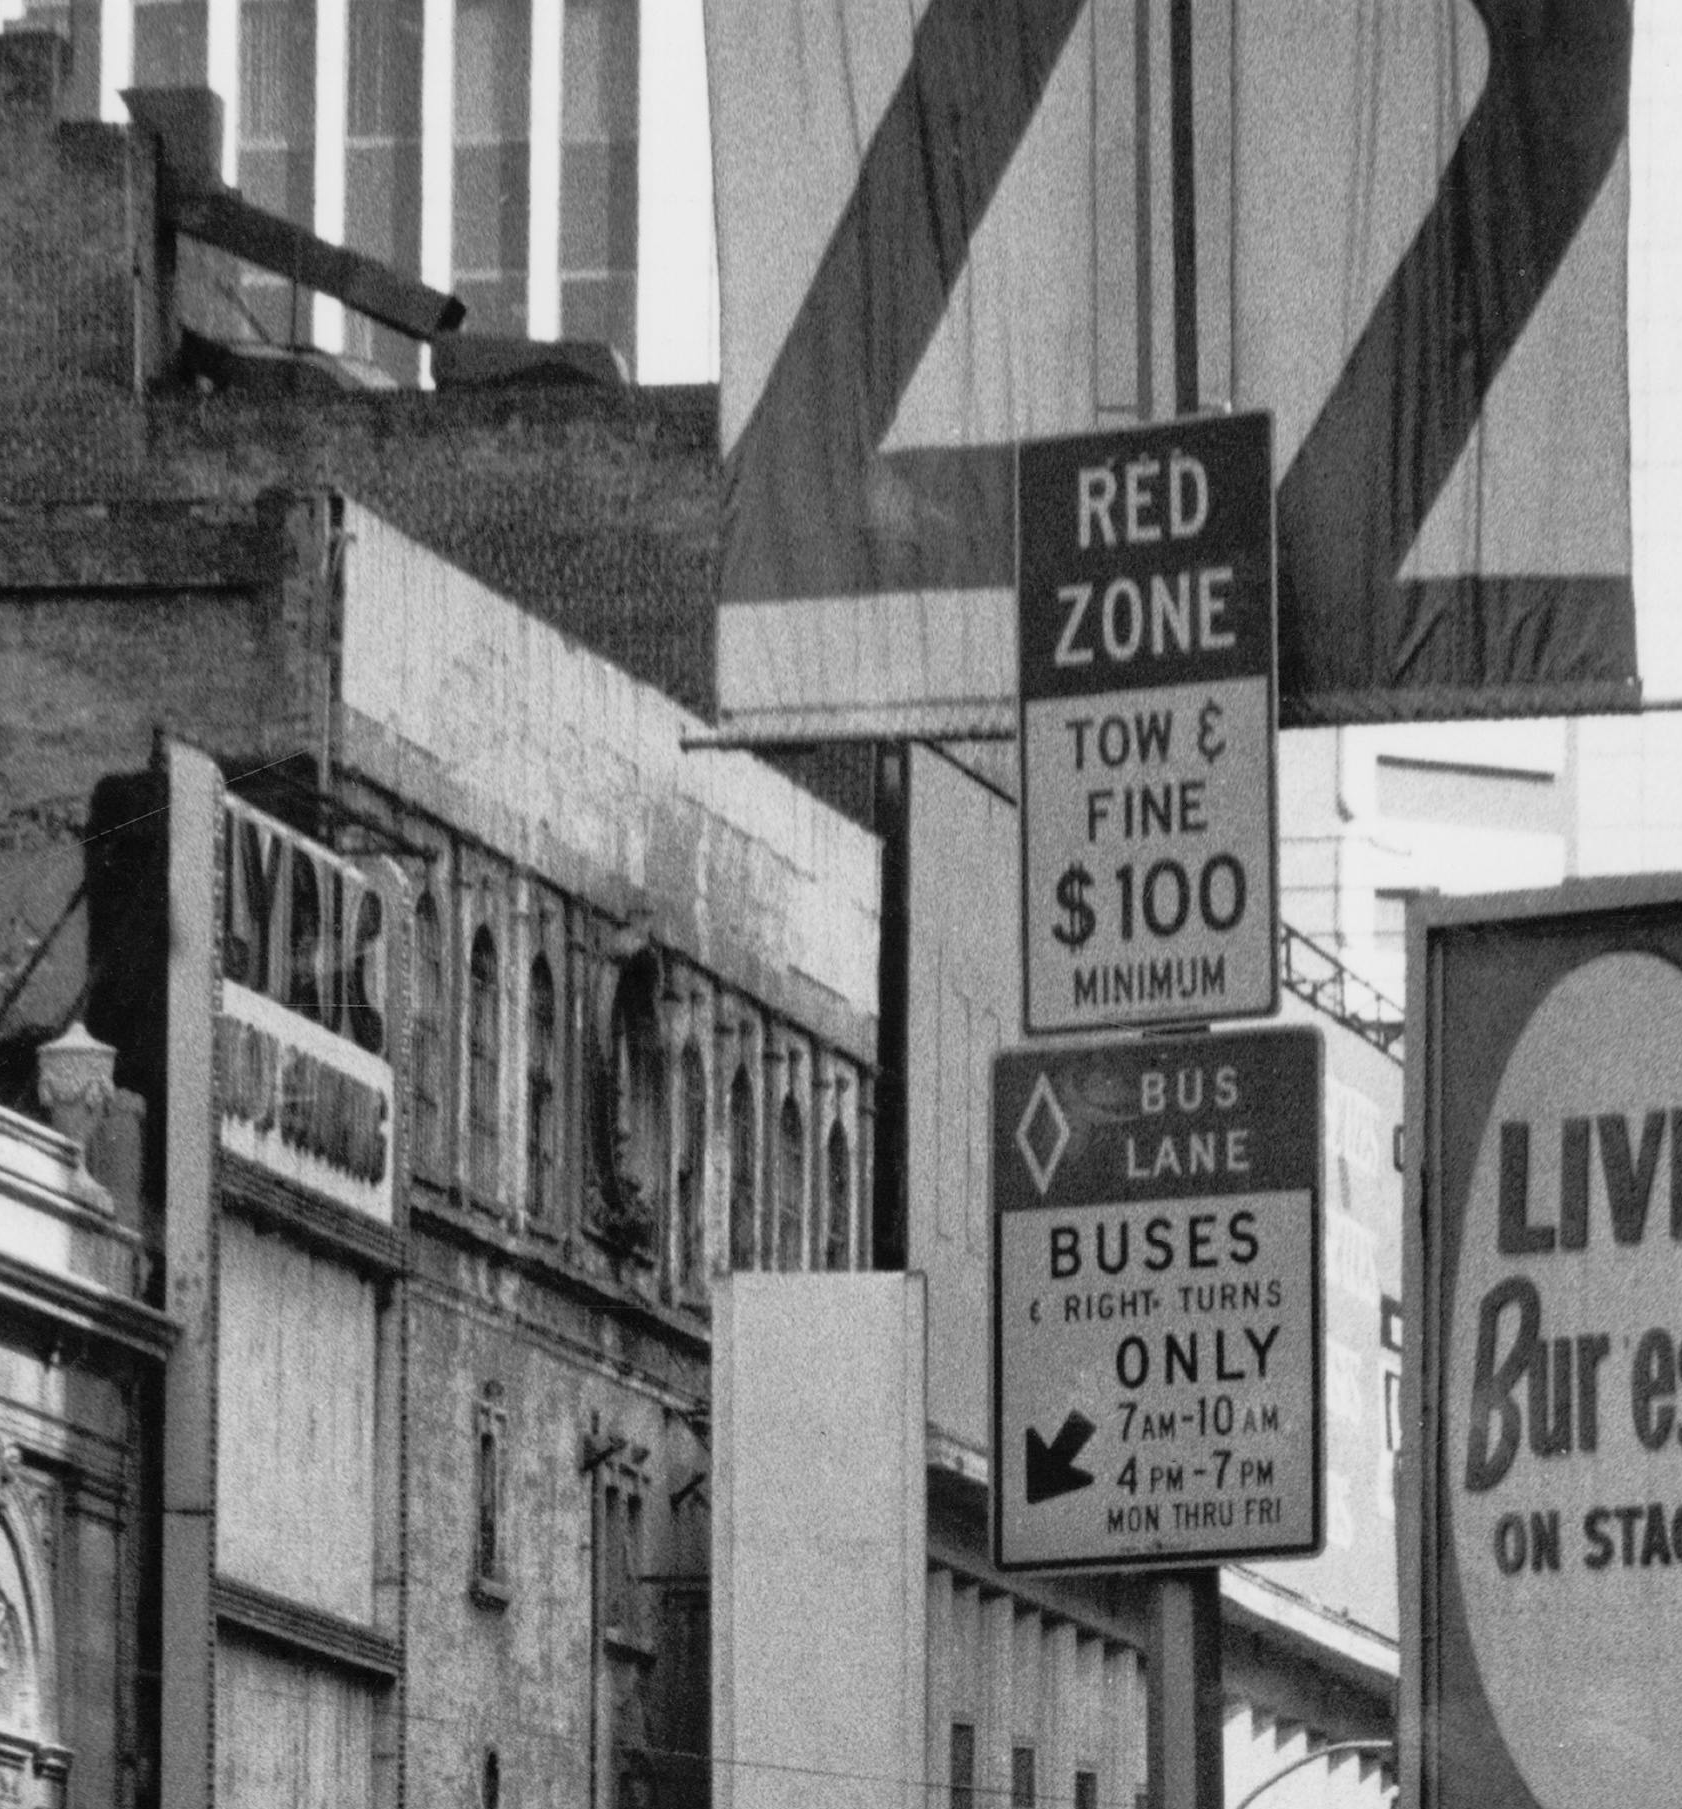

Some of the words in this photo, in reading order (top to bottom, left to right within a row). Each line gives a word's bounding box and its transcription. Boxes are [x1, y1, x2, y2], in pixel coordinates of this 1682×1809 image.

[1078, 452, 1209, 549] RED
[1054, 566, 1236, 668] ZONE
[1065, 710, 1174, 772] TOW
[1197, 699, 1226, 763] &
[1089, 780, 1208, 842] FINE
[1050, 853, 1247, 953] $100
[1074, 955, 1226, 1008] MINIMUM
[1141, 1066, 1238, 1115] BUS
[1126, 1130, 1251, 1181] LANE
[1050, 1211, 1259, 1280] BUSES
[1064, 1289, 1155, 1323] RIGHT
[1178, 1280, 1282, 1313] TURNS
[1116, 1326, 1281, 1389] ONLY
[1107, 1502, 1160, 1535] MON
[1172, 1500, 1234, 1530] THRU
[1245, 1498, 1282, 1525] FRI
[1494, 1509, 1561, 1577] ON
